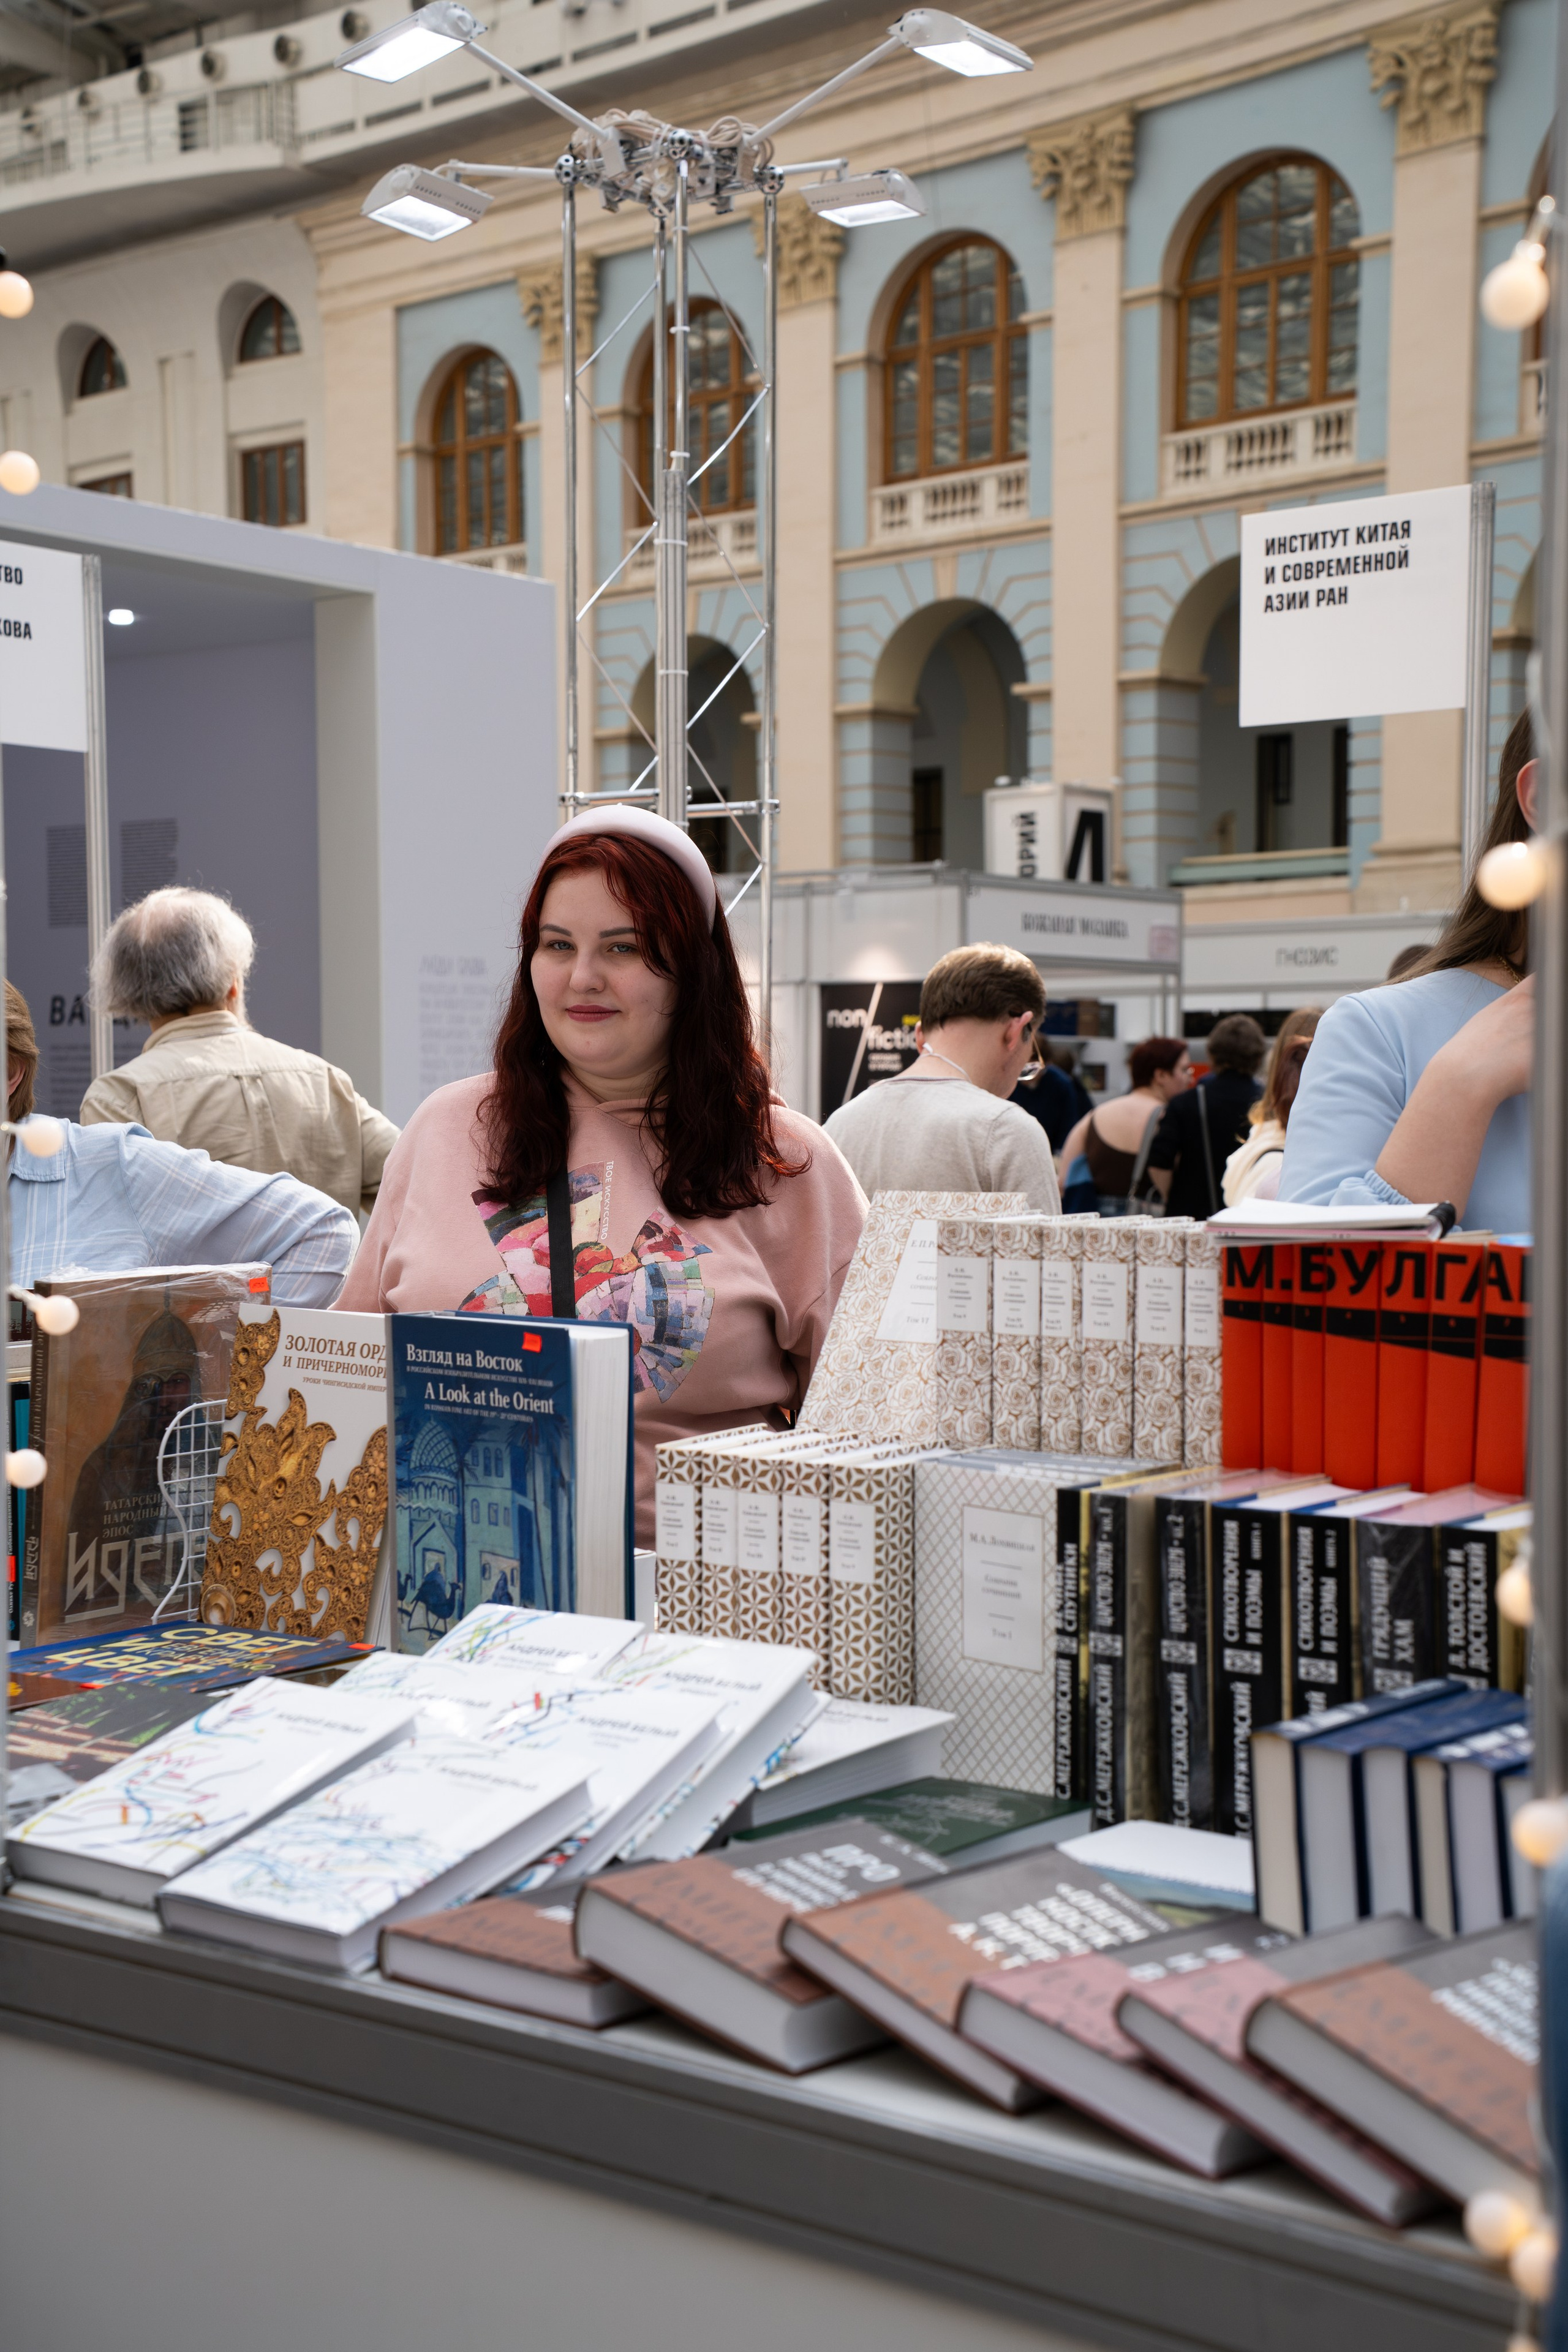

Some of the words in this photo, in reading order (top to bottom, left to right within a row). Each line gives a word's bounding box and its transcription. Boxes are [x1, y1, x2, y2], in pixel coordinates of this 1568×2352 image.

[1265, 528, 1350, 556] ИНСТИТУТ
[1355, 519, 1411, 545] КИТАЯ
[1264, 565, 1276, 584] И
[1282, 544, 1410, 583] СОВРЕМЕННОЙ
[1264, 590, 1310, 613] АЗИИ
[1316, 586, 1349, 607] РАН
[0, 618, 32, 639] ОВА
[827, 1009, 867, 1028] non
[867, 1025, 917, 1050] fictio
[285, 1335, 357, 1357] ЗОЛОТАЯ
[360, 1343, 386, 1363] ОРД
[406, 1343, 453, 1368] Взгляд
[456, 1352, 472, 1367] на
[475, 1349, 523, 1373] Восток
[282, 1355, 292, 1367] И
[296, 1357, 386, 1378] ПРИЧЕРНОМОР
[424, 1382, 435, 1400] A
[439, 1383, 470, 1404] Look
[473, 1390, 487, 1406] at
[489, 1387, 510, 1408] the
[513, 1391, 555, 1414] Orient
[104, 1493, 162, 1511] ТАТАРСКИ
[102, 1525, 134, 1539] ЭПОС
[1448, 1548, 1466, 1562] И
[1063, 1543, 1078, 1633] СПУТНИКИ
[1223, 1520, 1240, 1643] СТИХОТВОРЕНИЯ
[1297, 1526, 1314, 1652] СТИХОТВОРЕНИЯ
[1245, 1569, 1263, 1629] ПОЭМЫ
[1319, 1577, 1338, 1638] ПОЭМЫ
[1366, 1556, 1392, 1660] ГРЯДУЩИЙ
[1445, 1565, 1467, 1648] ТОЛСТОЙ
[1464, 1541, 1491, 1672] ДОСТОЕВСКИЙ
[160, 1627, 320, 1654] СВЕТ
[1246, 1632, 1262, 1645] И
[1320, 1640, 1338, 1654] И
[1393, 1619, 1415, 1664] ХАМ
[45, 1648, 216, 1677] ЦВЕТ
